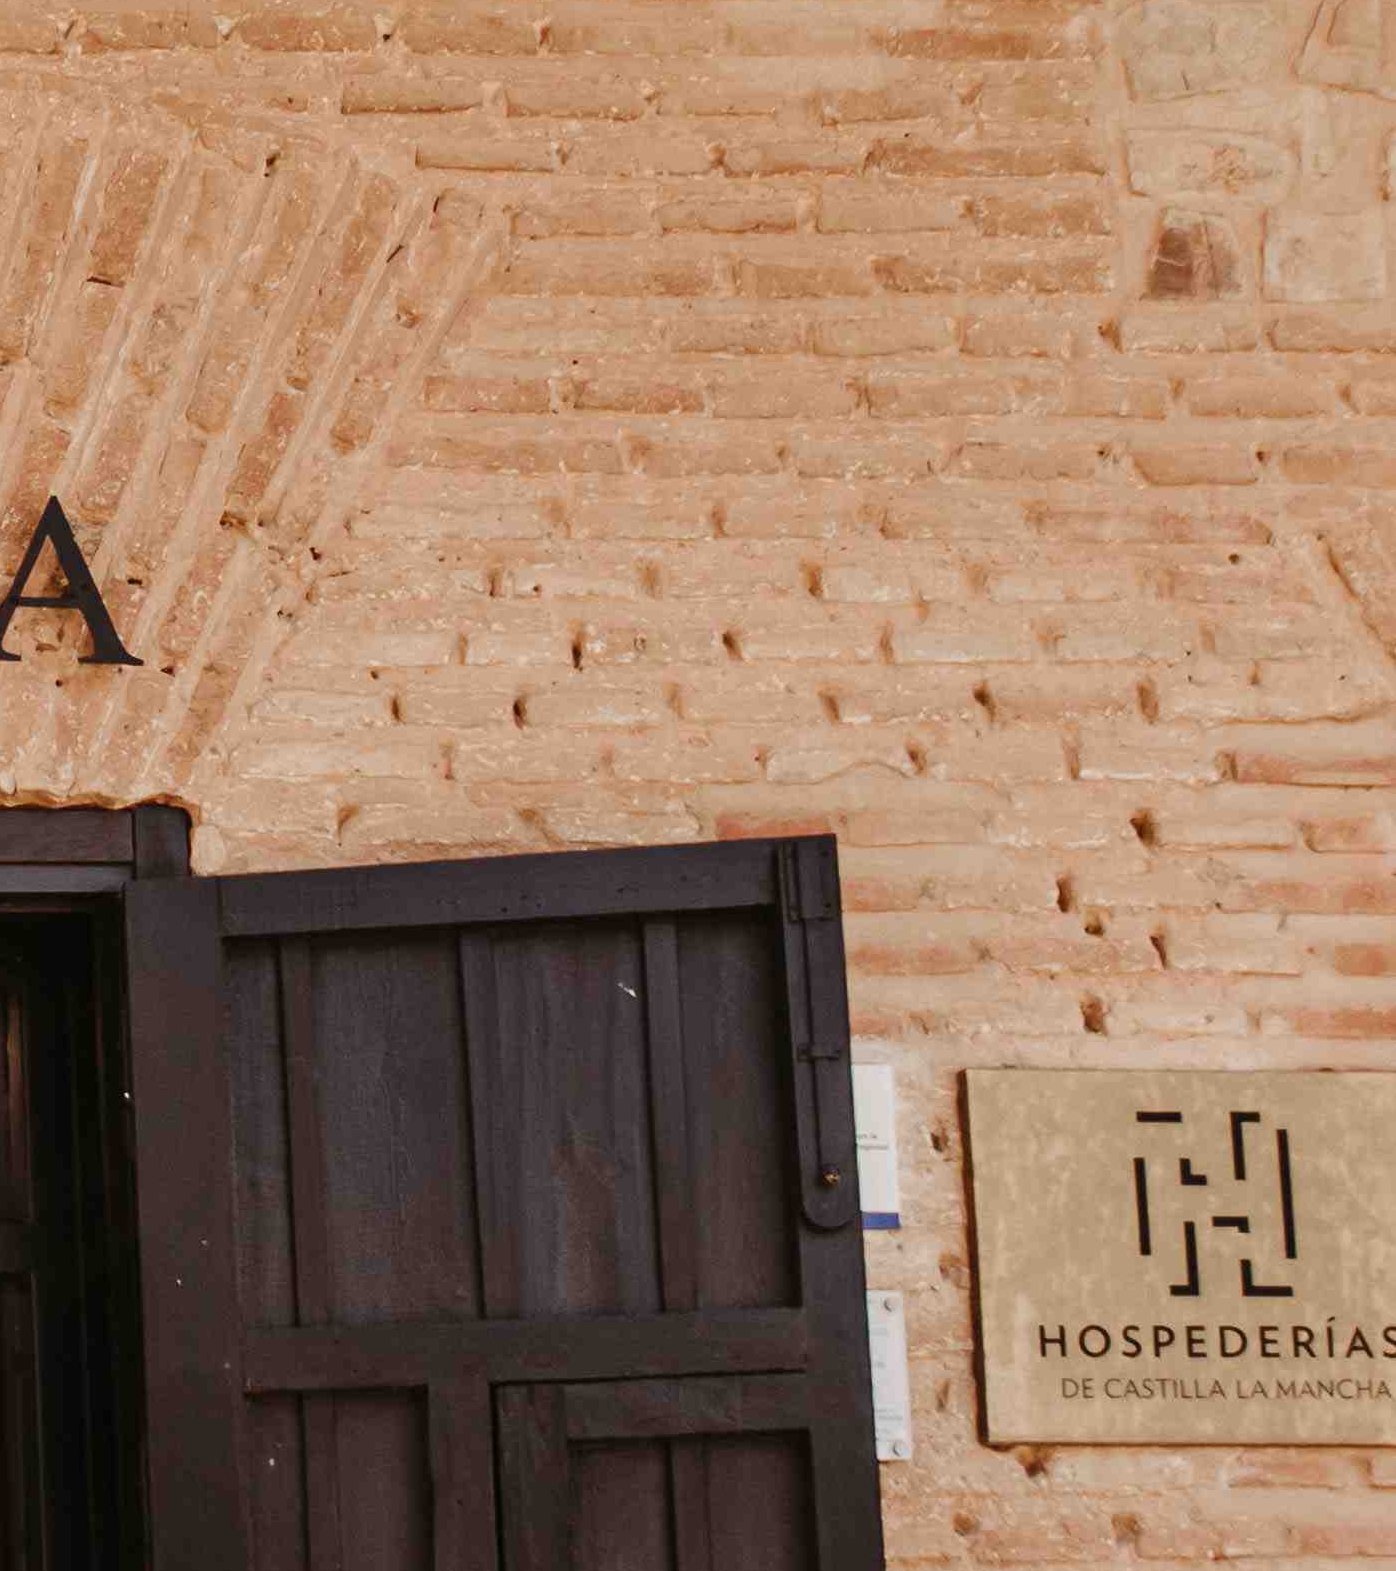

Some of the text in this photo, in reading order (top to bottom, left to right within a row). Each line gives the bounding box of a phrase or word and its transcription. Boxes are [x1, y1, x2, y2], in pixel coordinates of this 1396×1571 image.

[1039, 1316, 1396, 1359] HOSPEDERÍAS
[1060, 1377, 1394, 1401] DE CASTILLA LA MANCHA
